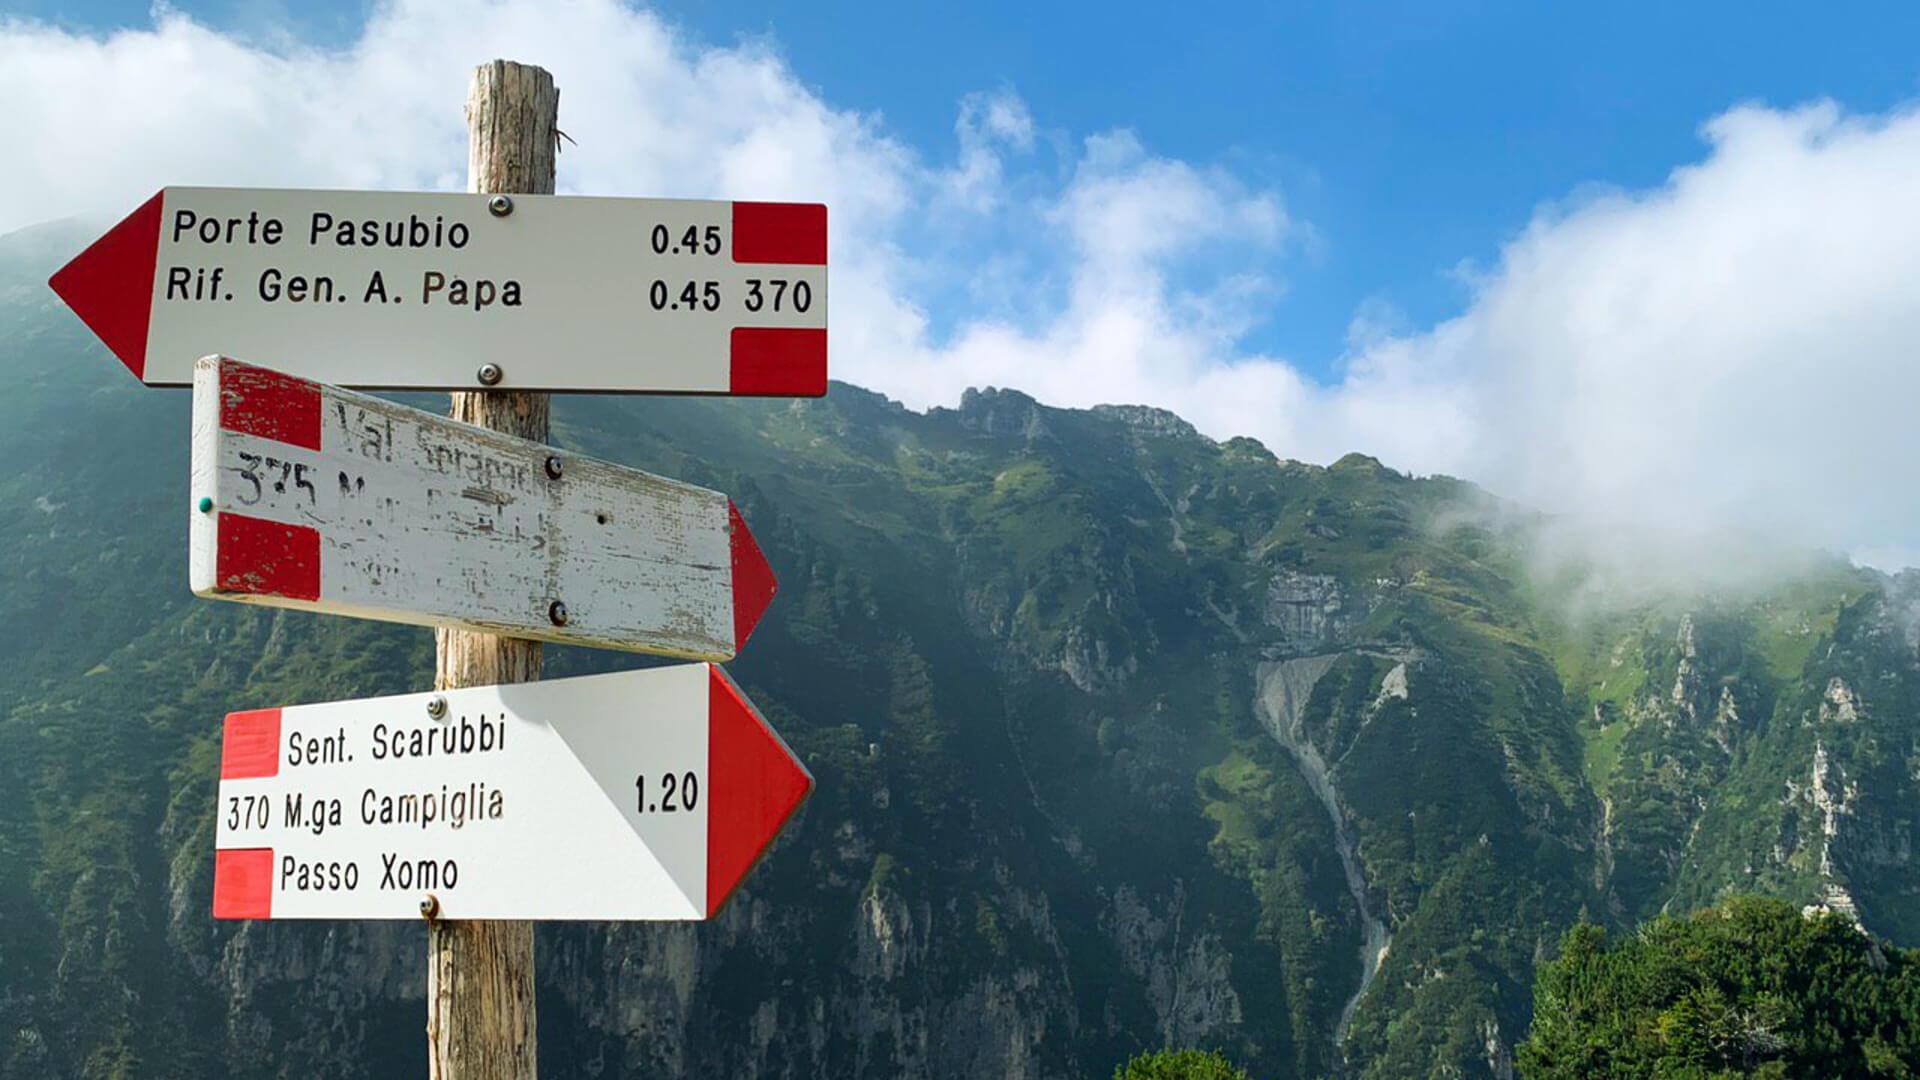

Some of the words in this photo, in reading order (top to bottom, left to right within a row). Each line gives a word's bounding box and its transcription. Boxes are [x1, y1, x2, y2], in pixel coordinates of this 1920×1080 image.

[174, 210, 284, 245] Porte
[311, 213, 470, 249] Pasubio
[652, 224, 721, 256] 0.45
[167, 267, 233, 301] Rif.
[259, 269, 347, 303] Gen.
[364, 271, 402, 304] A.
[423, 272, 523, 312] Papa
[650, 280, 720, 312] 0.45
[745, 280, 812, 314] 370
[288, 728, 354, 766] Sent.
[372, 713, 505, 760] Scarubbi
[228, 795, 270, 832] 370
[285, 793, 342, 836] M.ga
[361, 782, 504, 830] Campiglia
[636, 771, 699, 814] 1.20
[281, 856, 359, 892] Passo
[380, 853, 459, 891] Xomo
